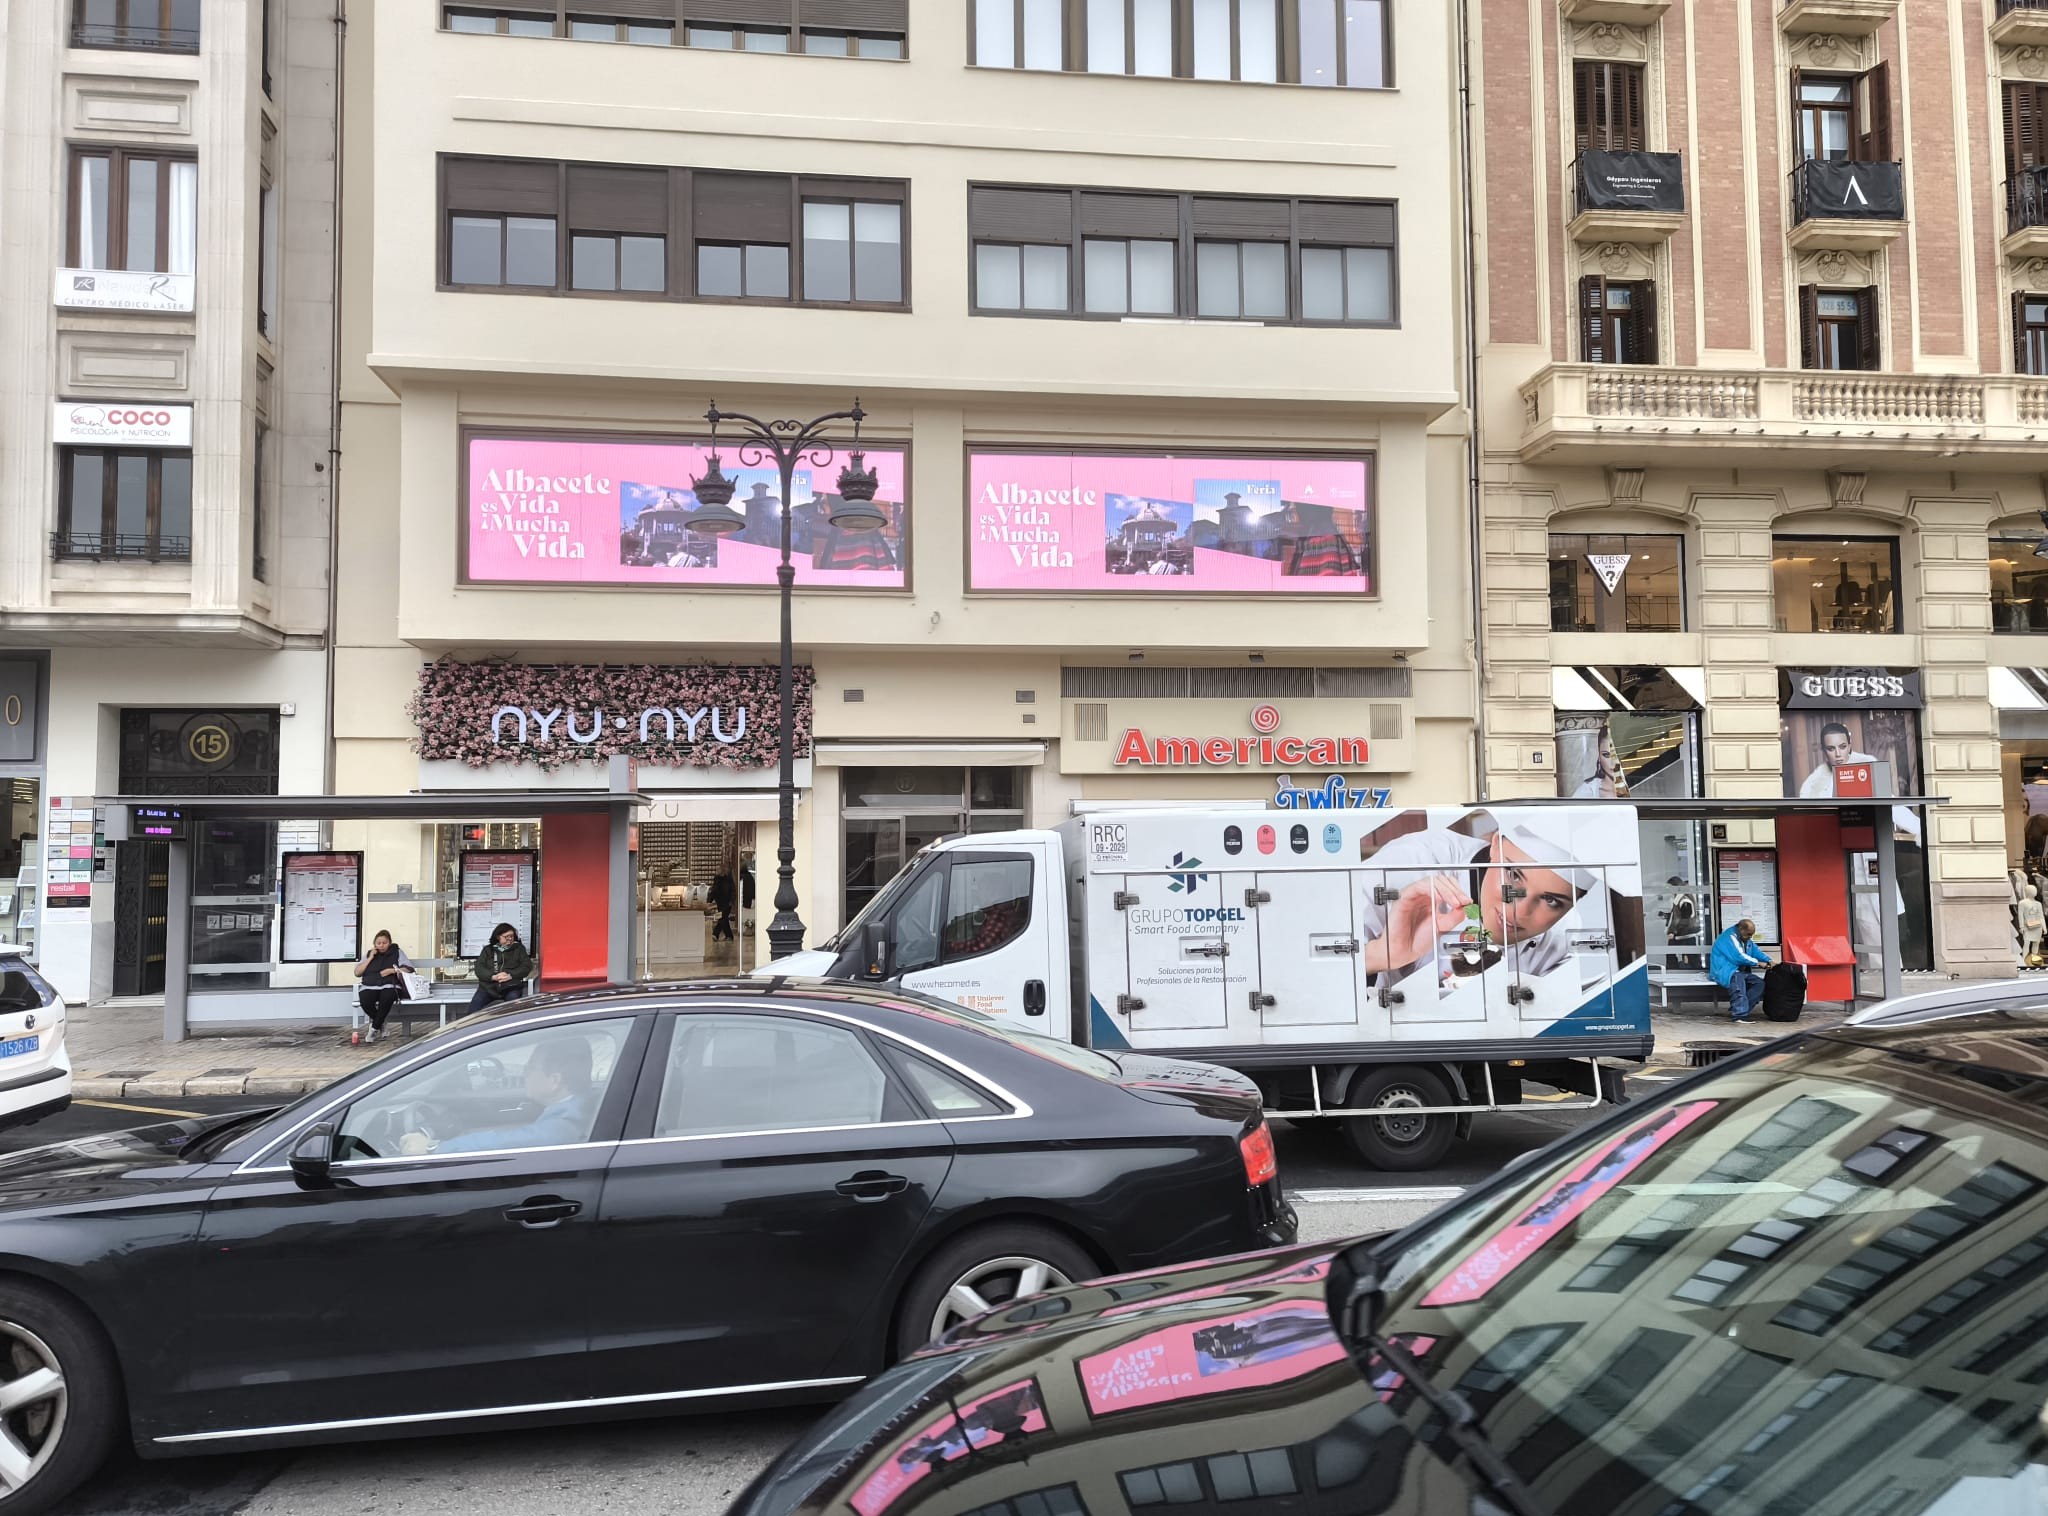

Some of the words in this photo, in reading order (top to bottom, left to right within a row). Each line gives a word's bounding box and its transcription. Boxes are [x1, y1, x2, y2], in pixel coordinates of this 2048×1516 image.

[108, 410, 171, 426] COCO
[481, 468, 611, 494] Albacete
[480, 502, 498, 513] es
[499, 493, 560, 514] Vida
[978, 482, 1096, 506] Albacete
[995, 505, 1050, 525] Vida
[512, 533, 585, 559] Vida
[1008, 543, 1073, 568] Vida
[1593, 555, 1626, 565] GUESS
[1801, 675, 1904, 697] GUESS
[197, 734, 223, 754] 15
[1114, 704, 1370, 765] American
[1094, 825, 1125, 843] RRC
[1134, 925, 1164, 935] Smart
[1167, 924, 1191, 934] Food
[1193, 924, 1239, 935] Company
[1136, 977, 1183, 986] Profesionales
[1184, 976, 1192, 984] de
[1158, 967, 1195, 976] Soluciones
[1196, 968, 1212, 976] para
